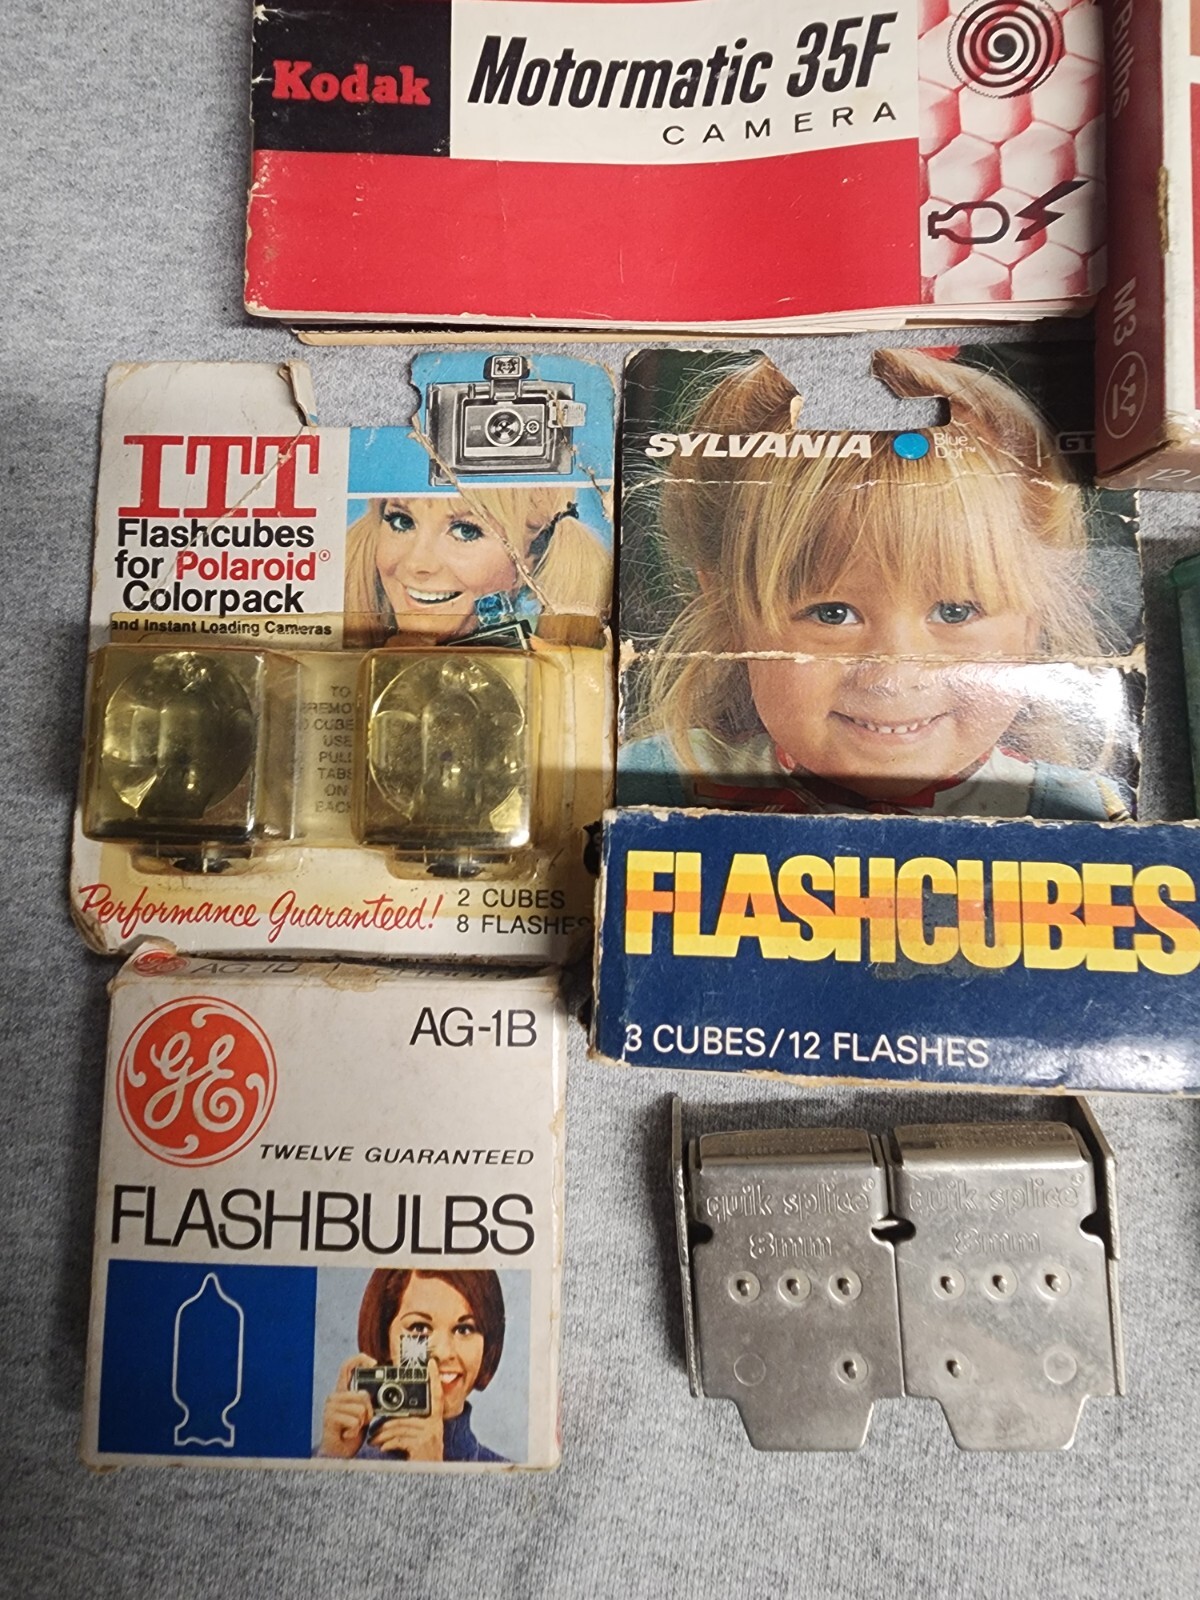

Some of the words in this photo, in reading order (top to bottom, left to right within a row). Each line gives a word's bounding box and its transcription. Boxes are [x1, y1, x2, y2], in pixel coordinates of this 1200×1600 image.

[467, 35, 774, 110] Motormatic
[786, 12, 898, 97] 35F
[272, 60, 430, 106] Kodak
[662, 102, 896, 146] CAMERA
[1113, 276, 1136, 346] M3
[645, 432, 872, 458] SYLVANIA
[933, 432, 968, 446] Blue
[1059, 434, 1095, 450] GT
[118, 435, 320, 518] ITT
[118, 518, 315, 548] Flashcubes
[114, 549, 164, 579] for
[122, 580, 305, 618] Colorpack
[112, 619, 139, 631] and
[144, 619, 197, 633] Instant
[201, 620, 260, 637] Loading
[264, 620, 332, 636] Cameras
[309, 701, 353, 715] REMO
[314, 718, 354, 732] CUBE
[78, 884, 261, 939] Performance
[269, 889, 444, 944] Guaranteed!
[457, 887, 471, 907] 2
[482, 887, 566, 909] CUBES
[624, 850, 1200, 976] FLASHCUBES
[456, 914, 469, 933] 8
[409, 1006, 538, 1048] AG-1B
[624, 1023, 643, 1053] 3
[652, 1023, 821, 1060] CUBES/12
[833, 1032, 990, 1069] FLASHES
[260, 1143, 354, 1163] TWELVE
[364, 1146, 535, 1166] GUARANTEED
[110, 1184, 536, 1256] FLASHBULBS
